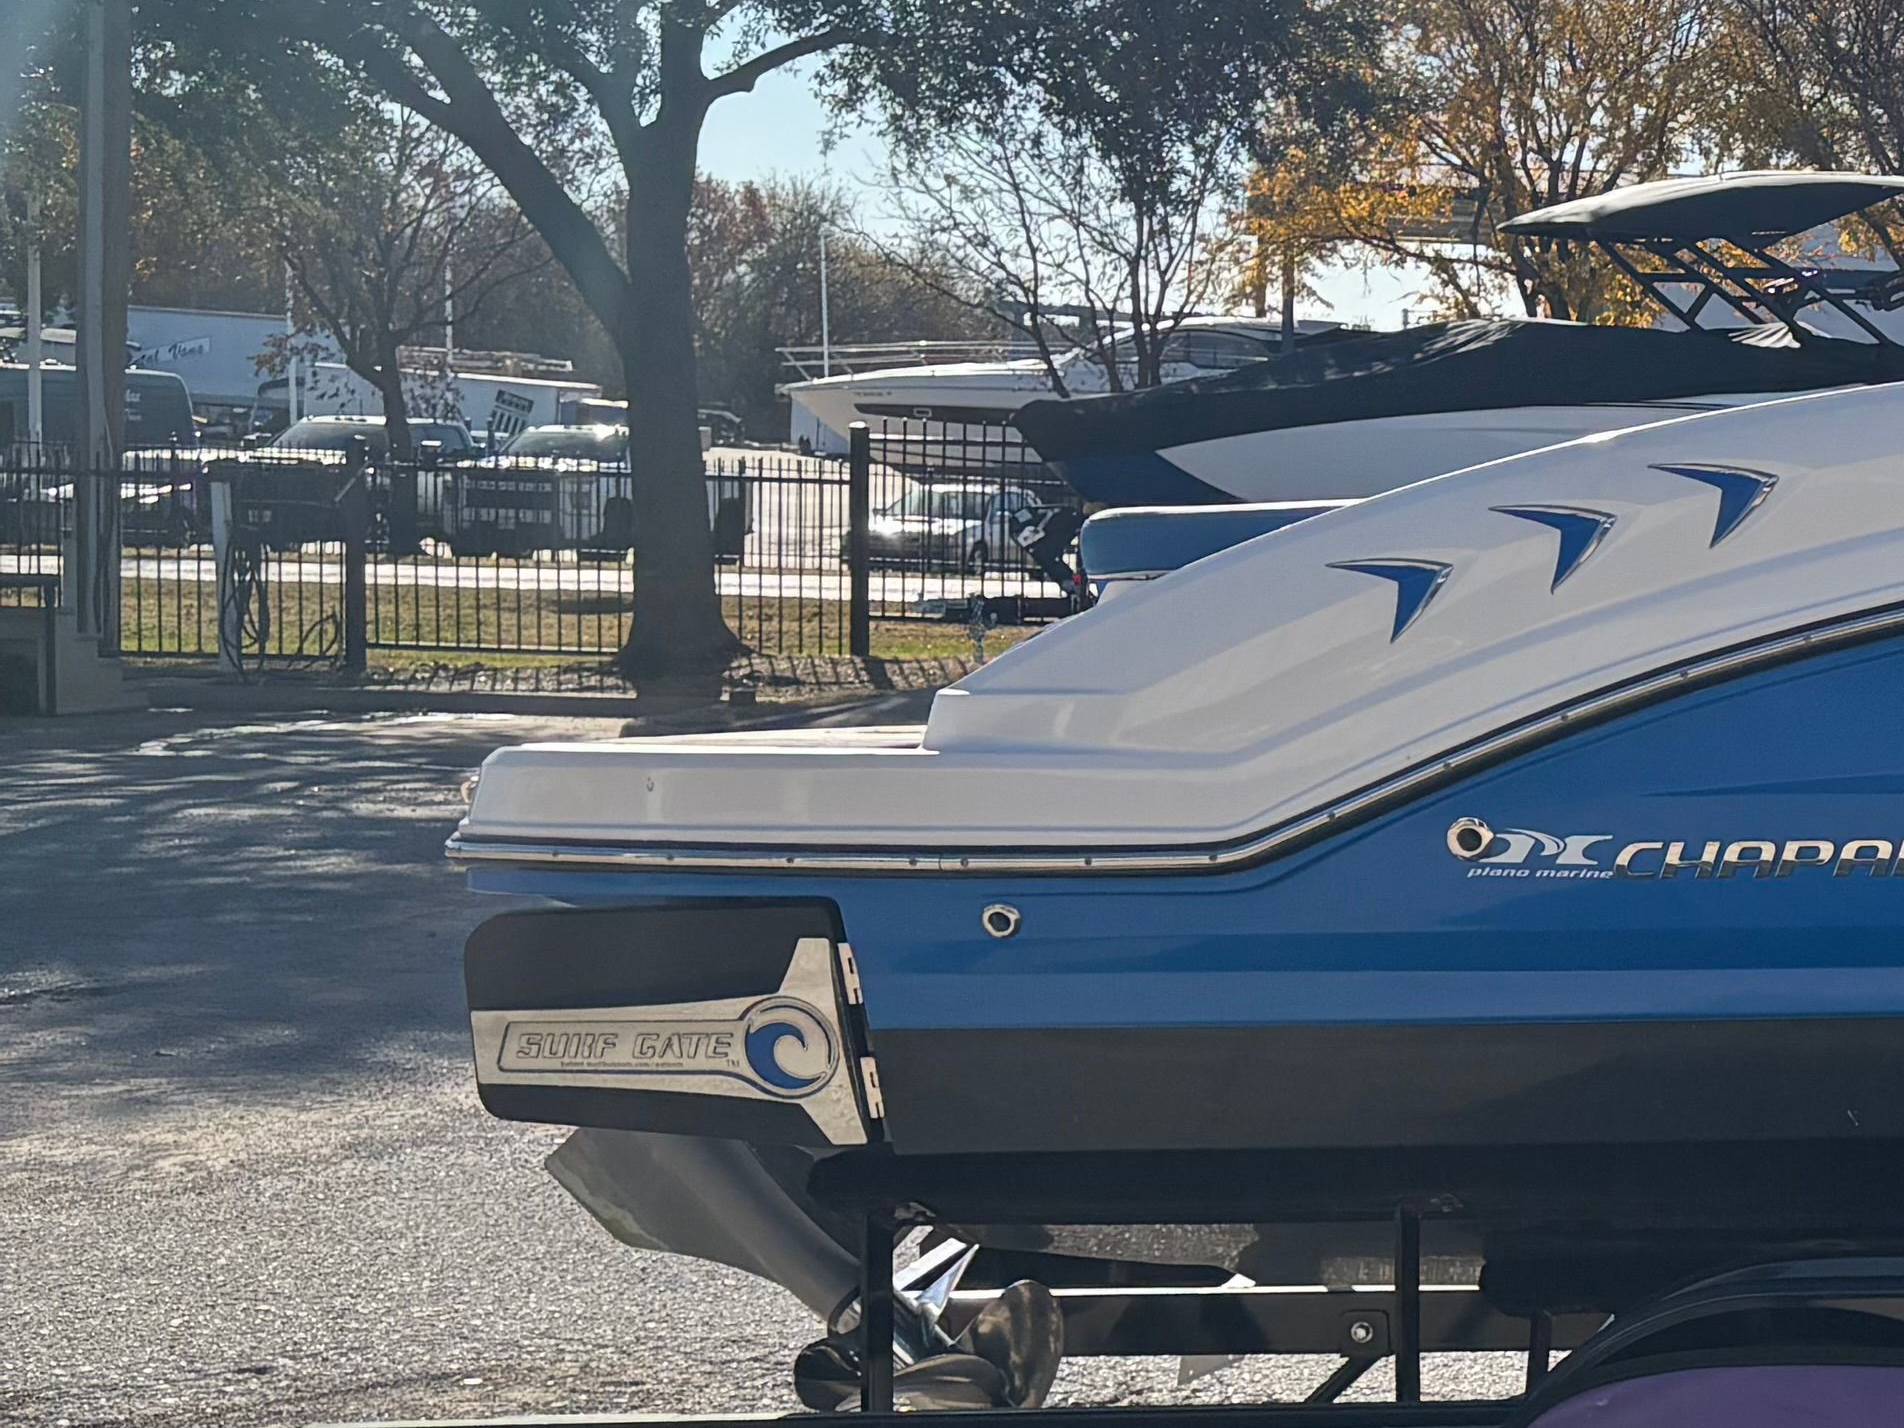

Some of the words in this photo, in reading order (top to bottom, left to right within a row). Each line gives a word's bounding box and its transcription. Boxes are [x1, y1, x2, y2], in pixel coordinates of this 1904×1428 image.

[1535, 867, 1614, 879] marine
[515, 1032, 618, 1059] SURF
[632, 1032, 734, 1059] GATE
